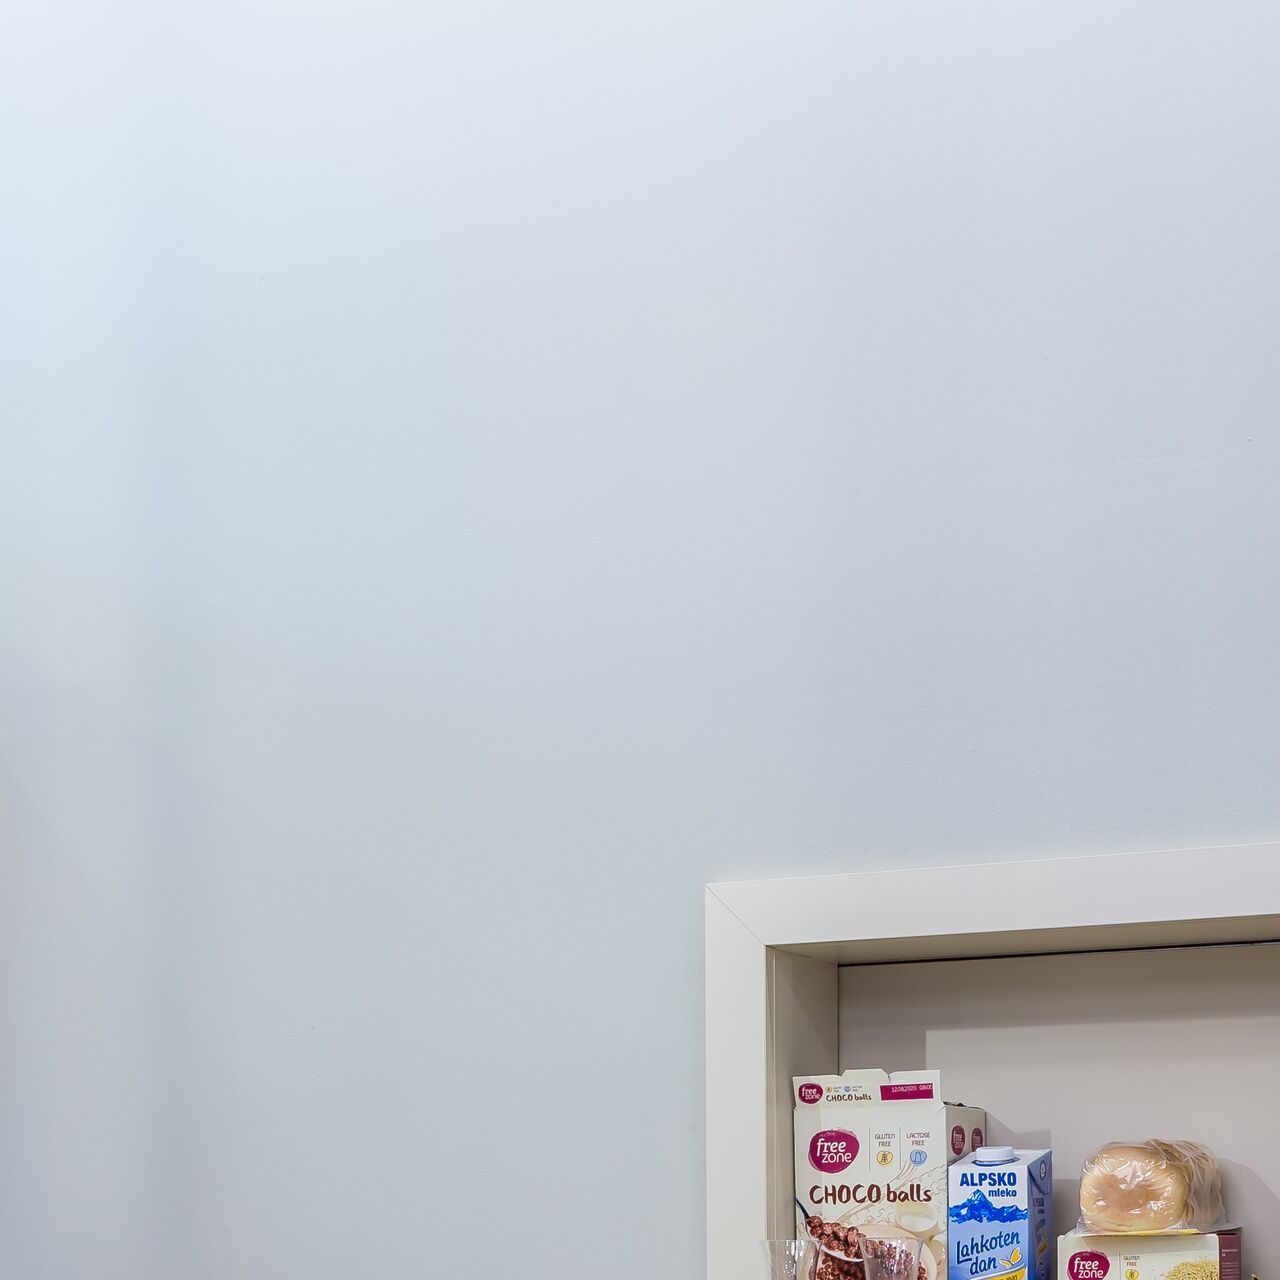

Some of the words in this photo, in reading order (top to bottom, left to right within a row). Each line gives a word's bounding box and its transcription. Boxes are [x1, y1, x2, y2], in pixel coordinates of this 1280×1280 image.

[801, 1086, 818, 1097] free
[826, 1093, 854, 1102] CHOCO
[854, 1093, 872, 1101] balls
[874, 1132, 896, 1140] GLUTEN
[906, 1131, 931, 1139] LACTOSE
[816, 1138, 846, 1156] free
[911, 1139, 925, 1147] FREE
[821, 1151, 853, 1164] zone
[959, 1172, 1017, 1187] ALPSKO
[809, 1184, 882, 1205] CHOCO
[886, 1183, 933, 1204] balls
[988, 1187, 1017, 1198] mleko
[956, 1231, 1021, 1265] Lahkoten
[969, 1256, 998, 1276] dan
[1073, 1257, 1099, 1273] free
[1078, 1268, 1104, 1279] zone
